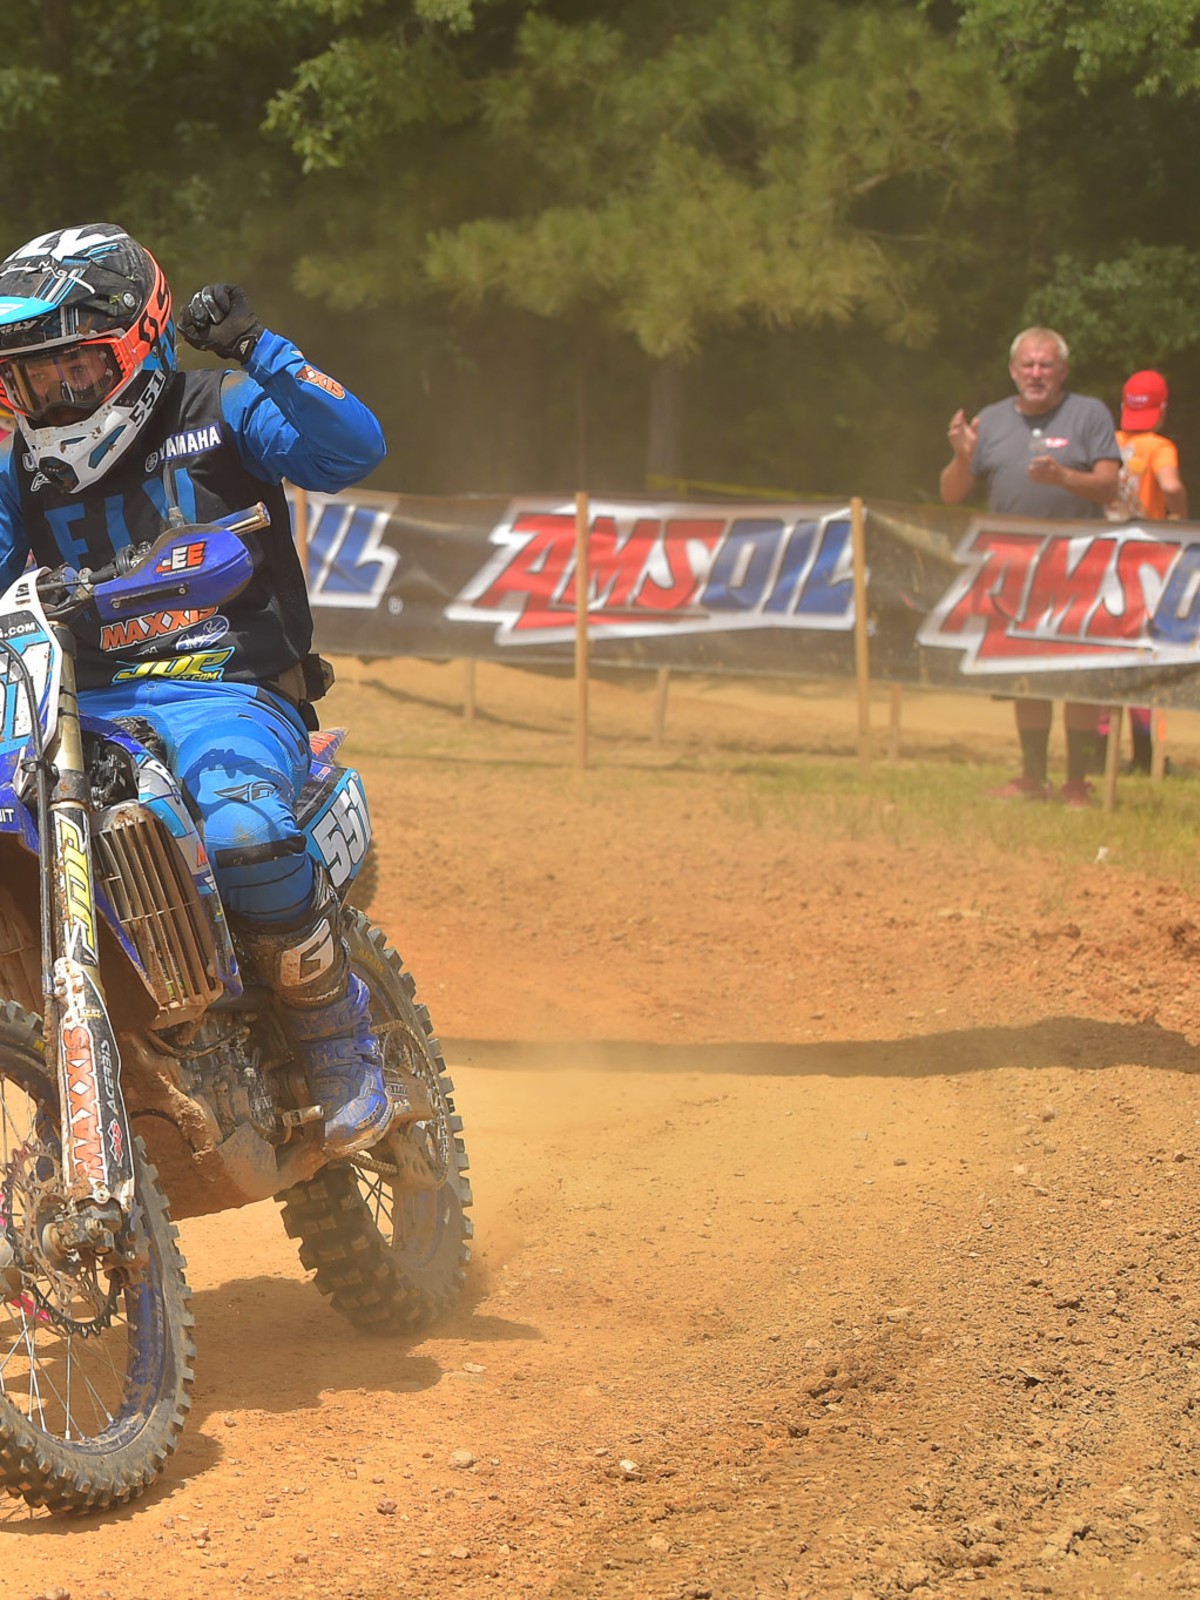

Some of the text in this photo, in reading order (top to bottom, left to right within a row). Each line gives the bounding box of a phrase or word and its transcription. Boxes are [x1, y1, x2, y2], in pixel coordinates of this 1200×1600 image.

[129, 370, 166, 428] 551
[159, 426, 222, 460] YAMAHA
[471, 511, 856, 620] AMSOIL
[116, 651, 232, 680] JDP
[311, 779, 372, 887] 551
[63, 1026, 105, 1181] MAXXIS
